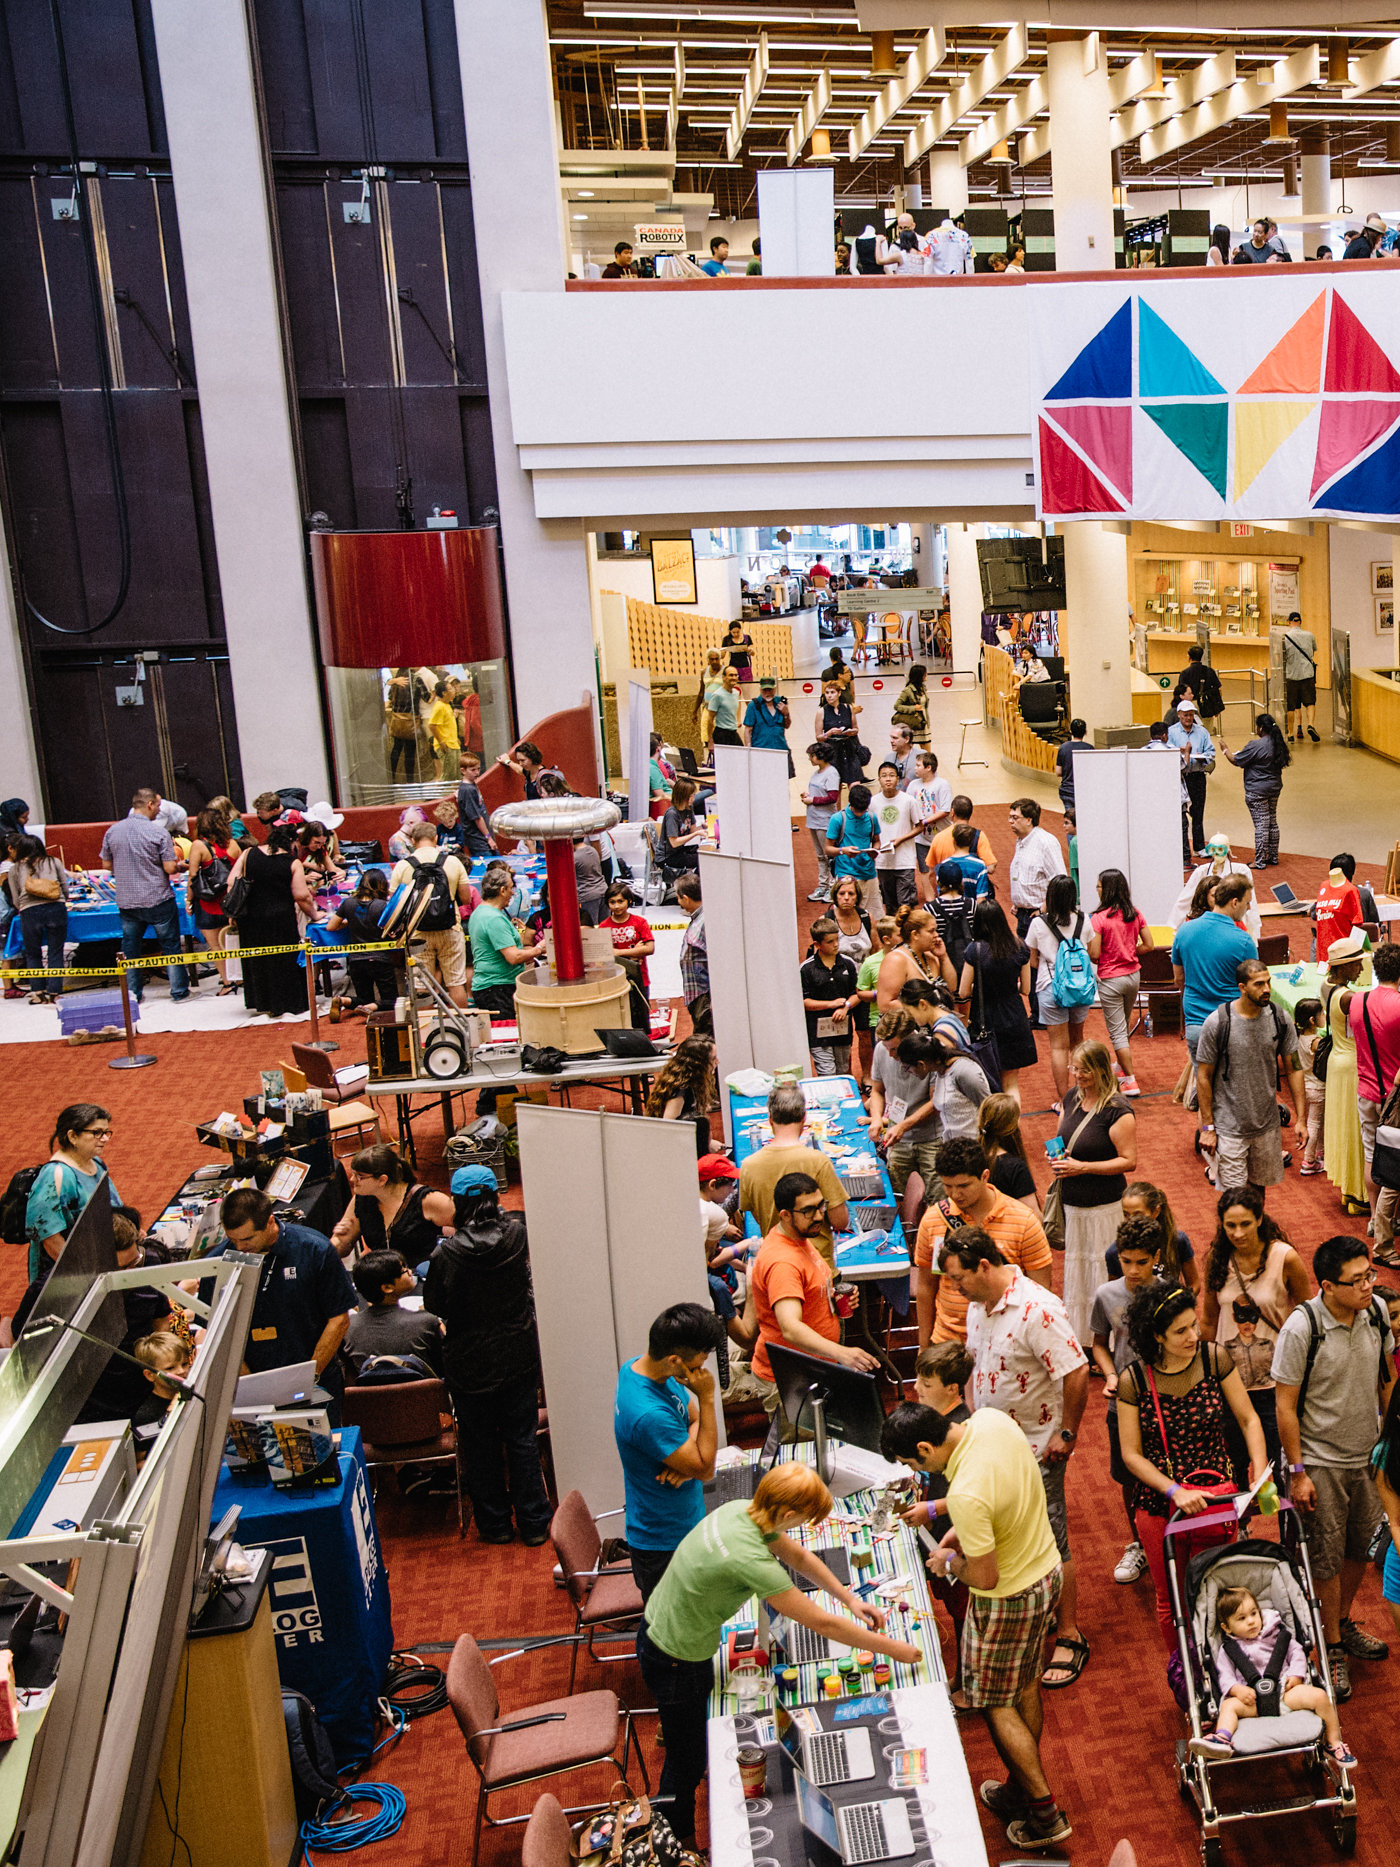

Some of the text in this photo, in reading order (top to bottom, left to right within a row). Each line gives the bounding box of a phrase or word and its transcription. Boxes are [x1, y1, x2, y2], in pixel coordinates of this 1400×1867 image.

[640, 233, 684, 243] ROBOTIX
[1234, 523, 1249, 536] EXIT
[1328, 899, 1342, 910] my
[324, 944, 367, 953] CAUTION
[138, 956, 184, 967] CAUTION
[205, 949, 252, 961] CAUTION
[254, 945, 300, 956] CAUTION
[17, 968, 116, 977] CAUTION CAUTION
